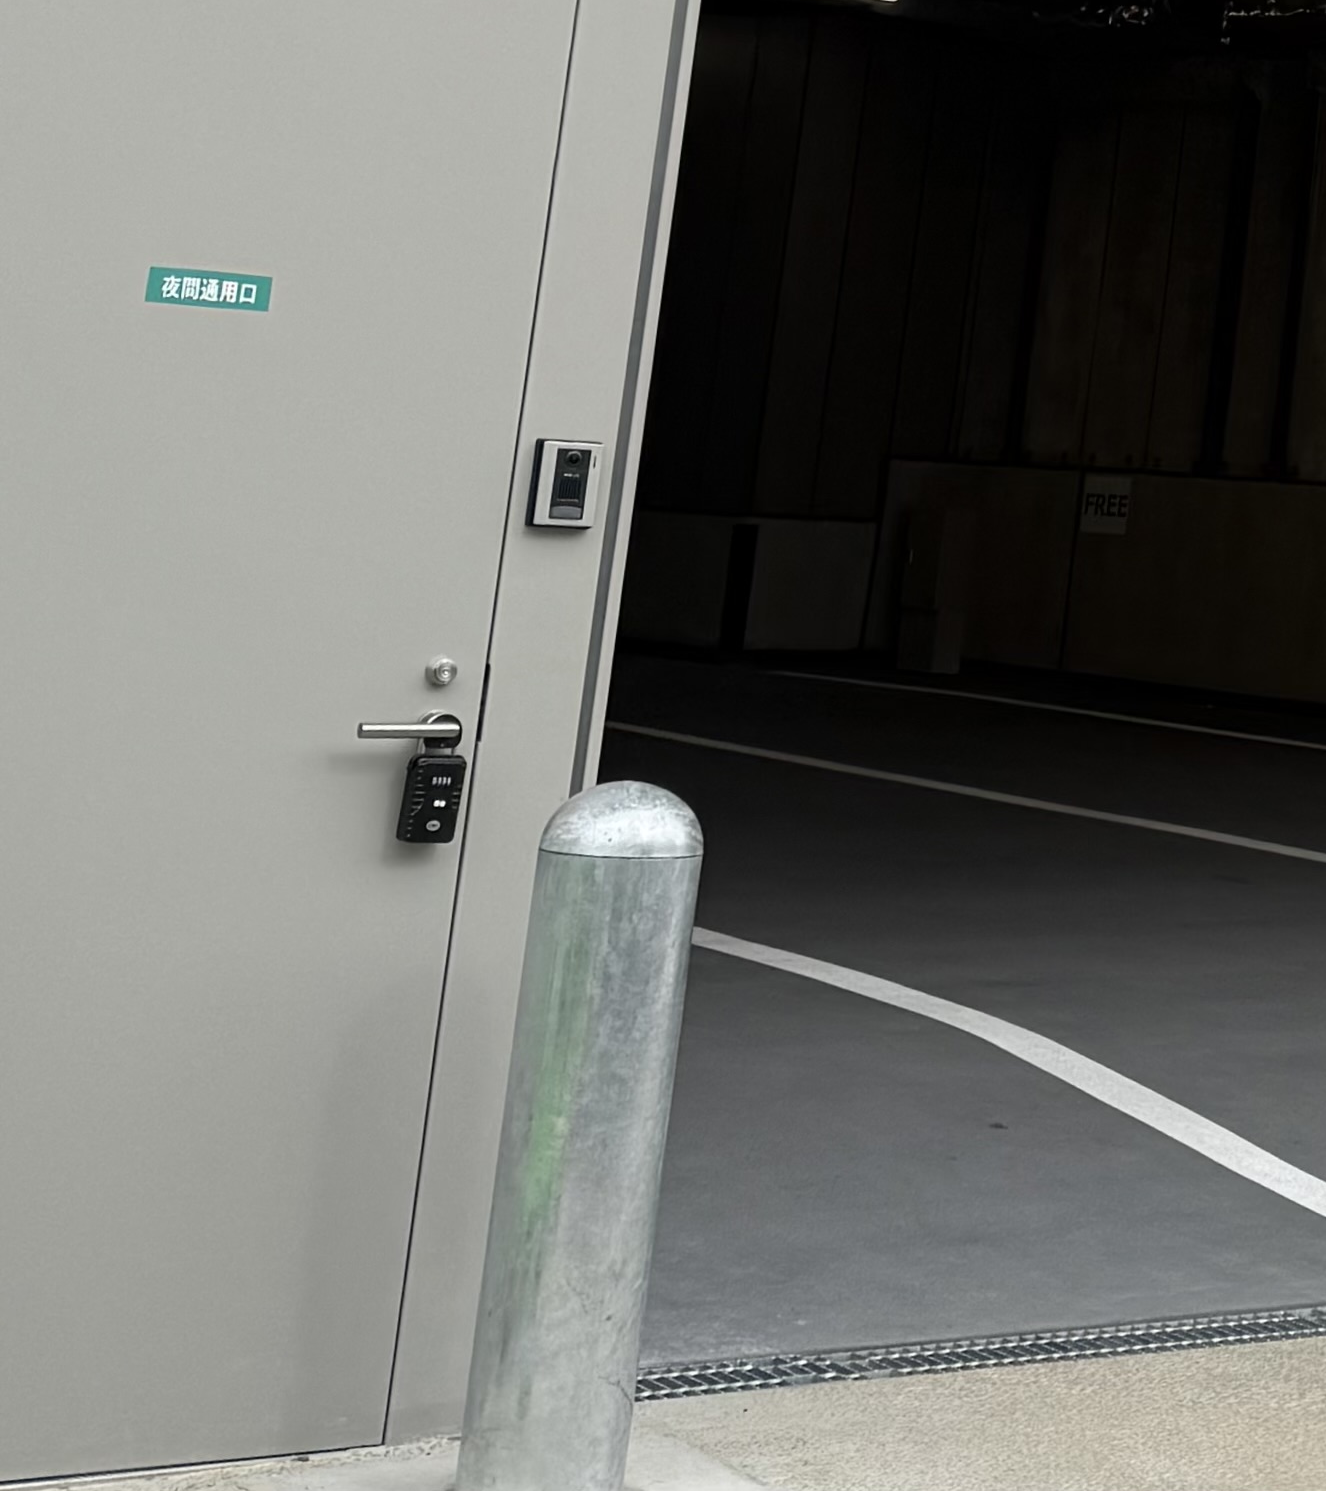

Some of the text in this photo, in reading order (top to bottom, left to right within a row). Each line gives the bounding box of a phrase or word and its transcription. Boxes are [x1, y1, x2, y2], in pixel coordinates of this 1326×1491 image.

[161, 275, 257, 304] 夜間通用口
[1084, 493, 1129, 517] FREE
